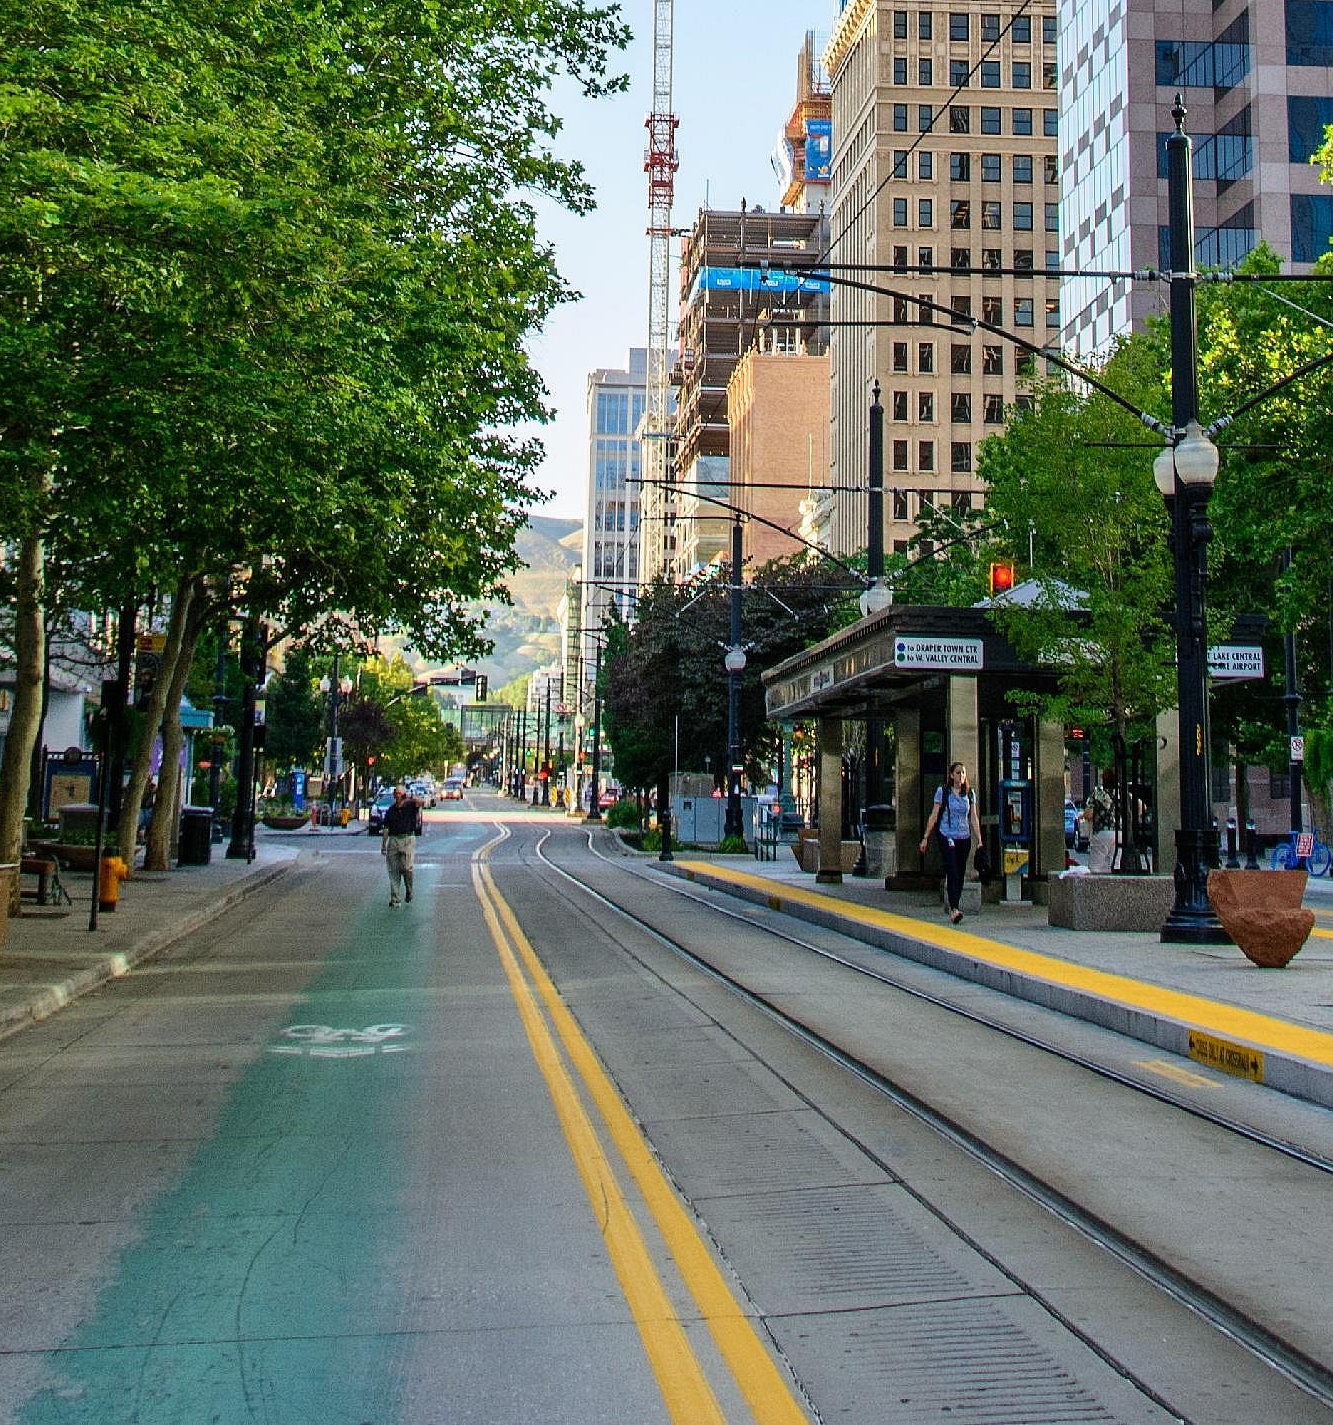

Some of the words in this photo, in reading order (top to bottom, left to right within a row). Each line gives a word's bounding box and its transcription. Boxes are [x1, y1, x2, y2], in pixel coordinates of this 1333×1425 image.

[916, 643, 941, 653] DRAPER
[943, 645, 964, 654] TOWN
[965, 645, 978, 654] CTR
[907, 654, 915, 662] to
[925, 655, 948, 663] VALLEY
[949, 655, 979, 664] CENTRAL
[1213, 652, 1230, 661] LAKE
[1231, 652, 1261, 661] CENTRAL
[1232, 662, 1261, 671] AIRPORT
